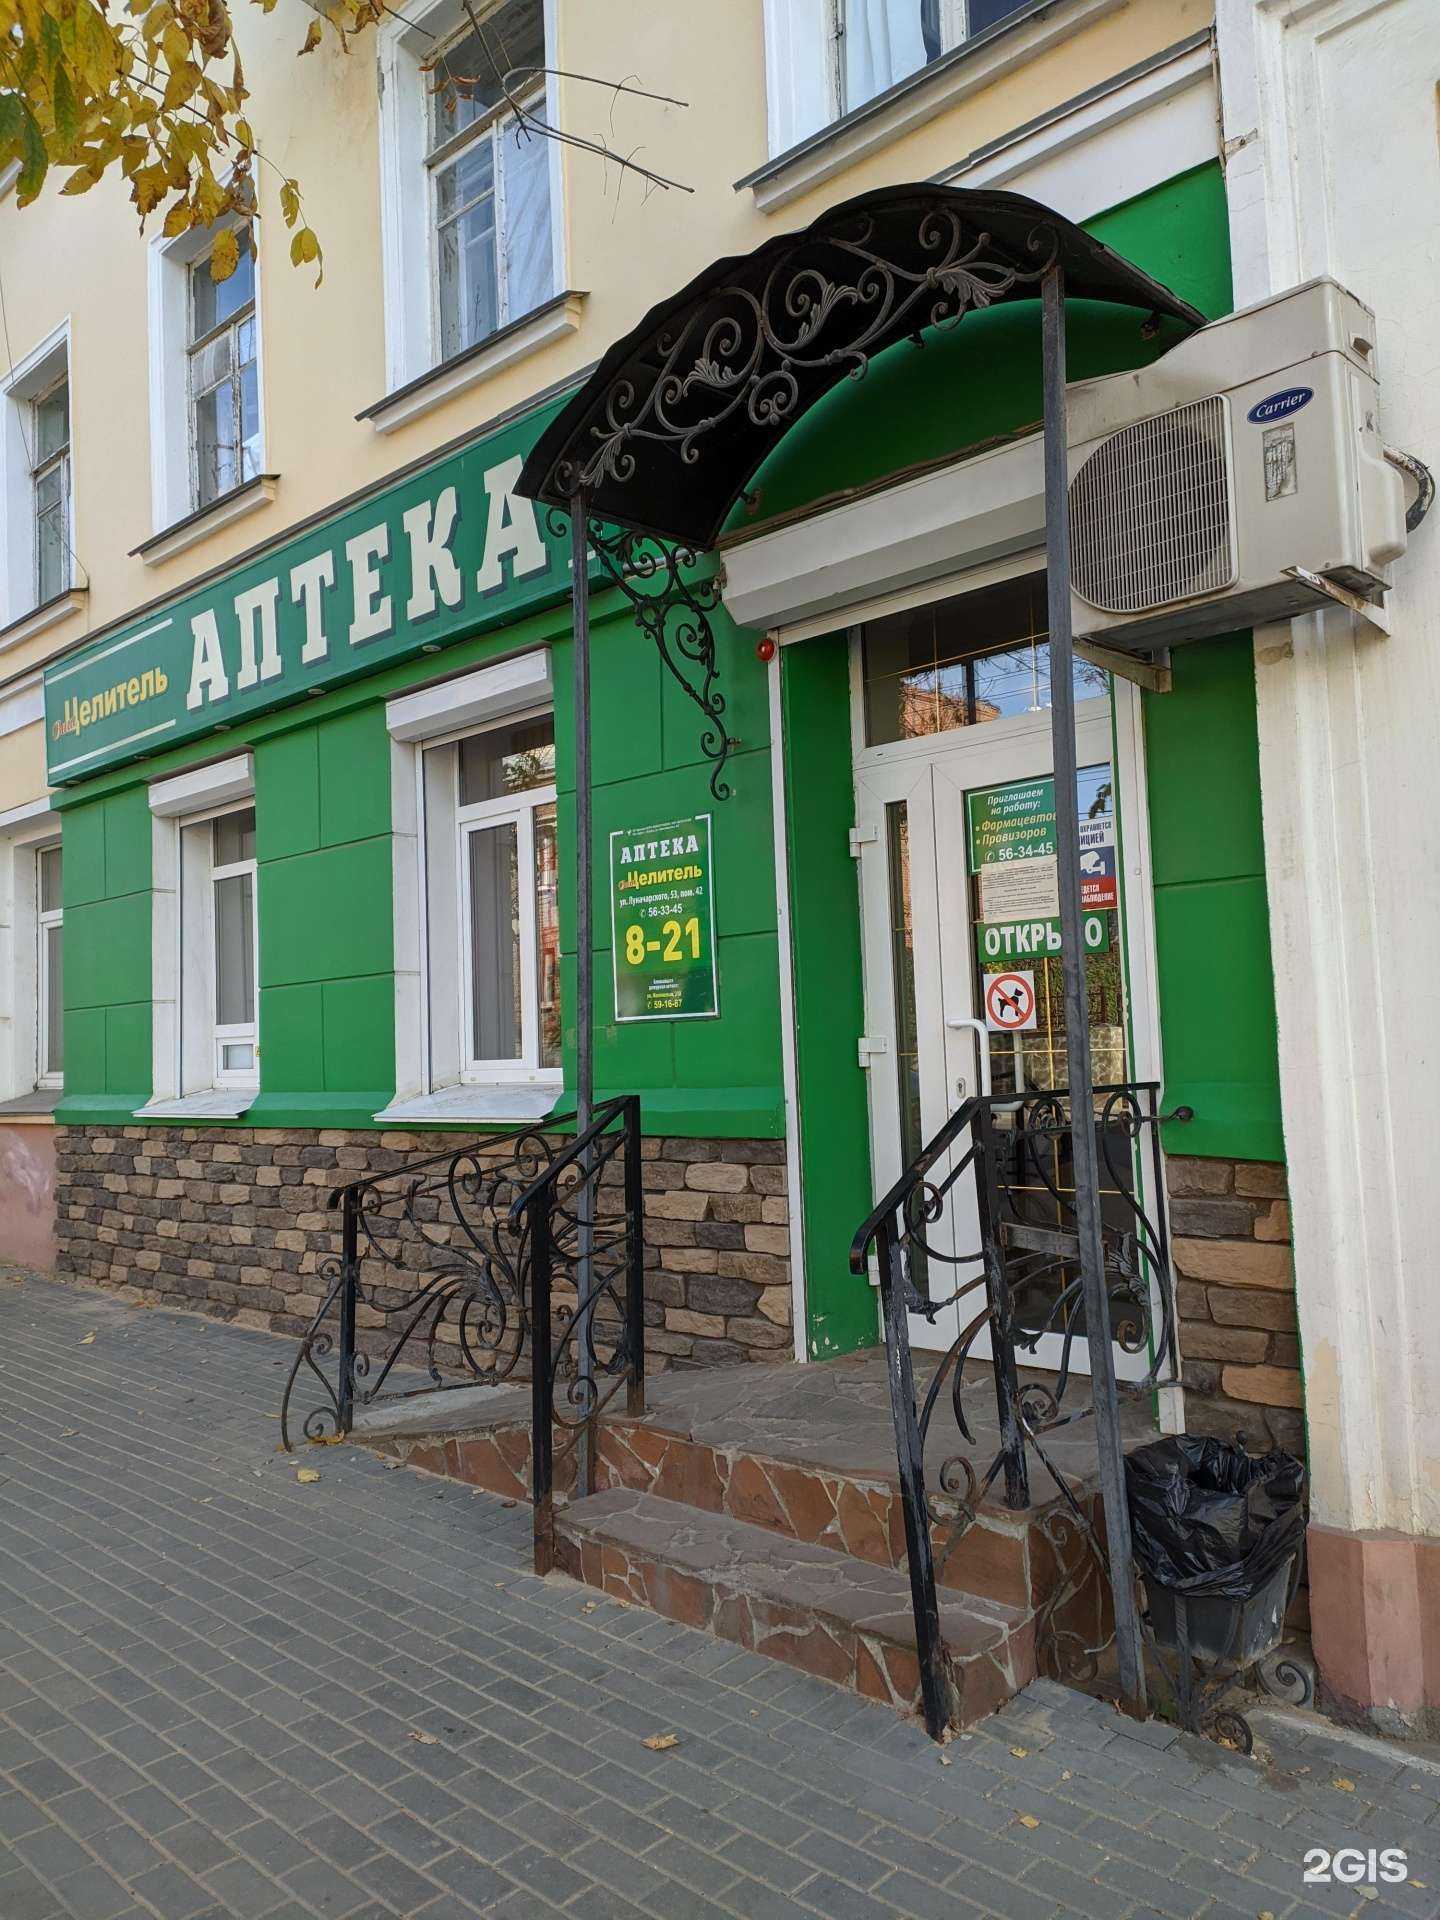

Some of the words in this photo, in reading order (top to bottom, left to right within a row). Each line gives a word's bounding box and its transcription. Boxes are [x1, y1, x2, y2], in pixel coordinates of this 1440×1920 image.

[1256, 392, 1306, 418] Carrier
[185, 454, 548, 711] АПТЕКА
[64, 667, 168, 736] Целитель
[987, 789, 1043, 806] Приглашаем
[991, 808, 1001, 816] на
[1002, 800, 1041, 816] работу:
[982, 828, 1047, 847] Провизоров
[1080, 831, 1105, 846] ИЦИЕЙ
[620, 834, 699, 865] АПТЕКА
[998, 842, 1053, 861] 56-34-45
[627, 863, 703, 890] Целитель
[648, 903, 683, 917] 56-33-45
[626, 918, 700, 965] 8-21
